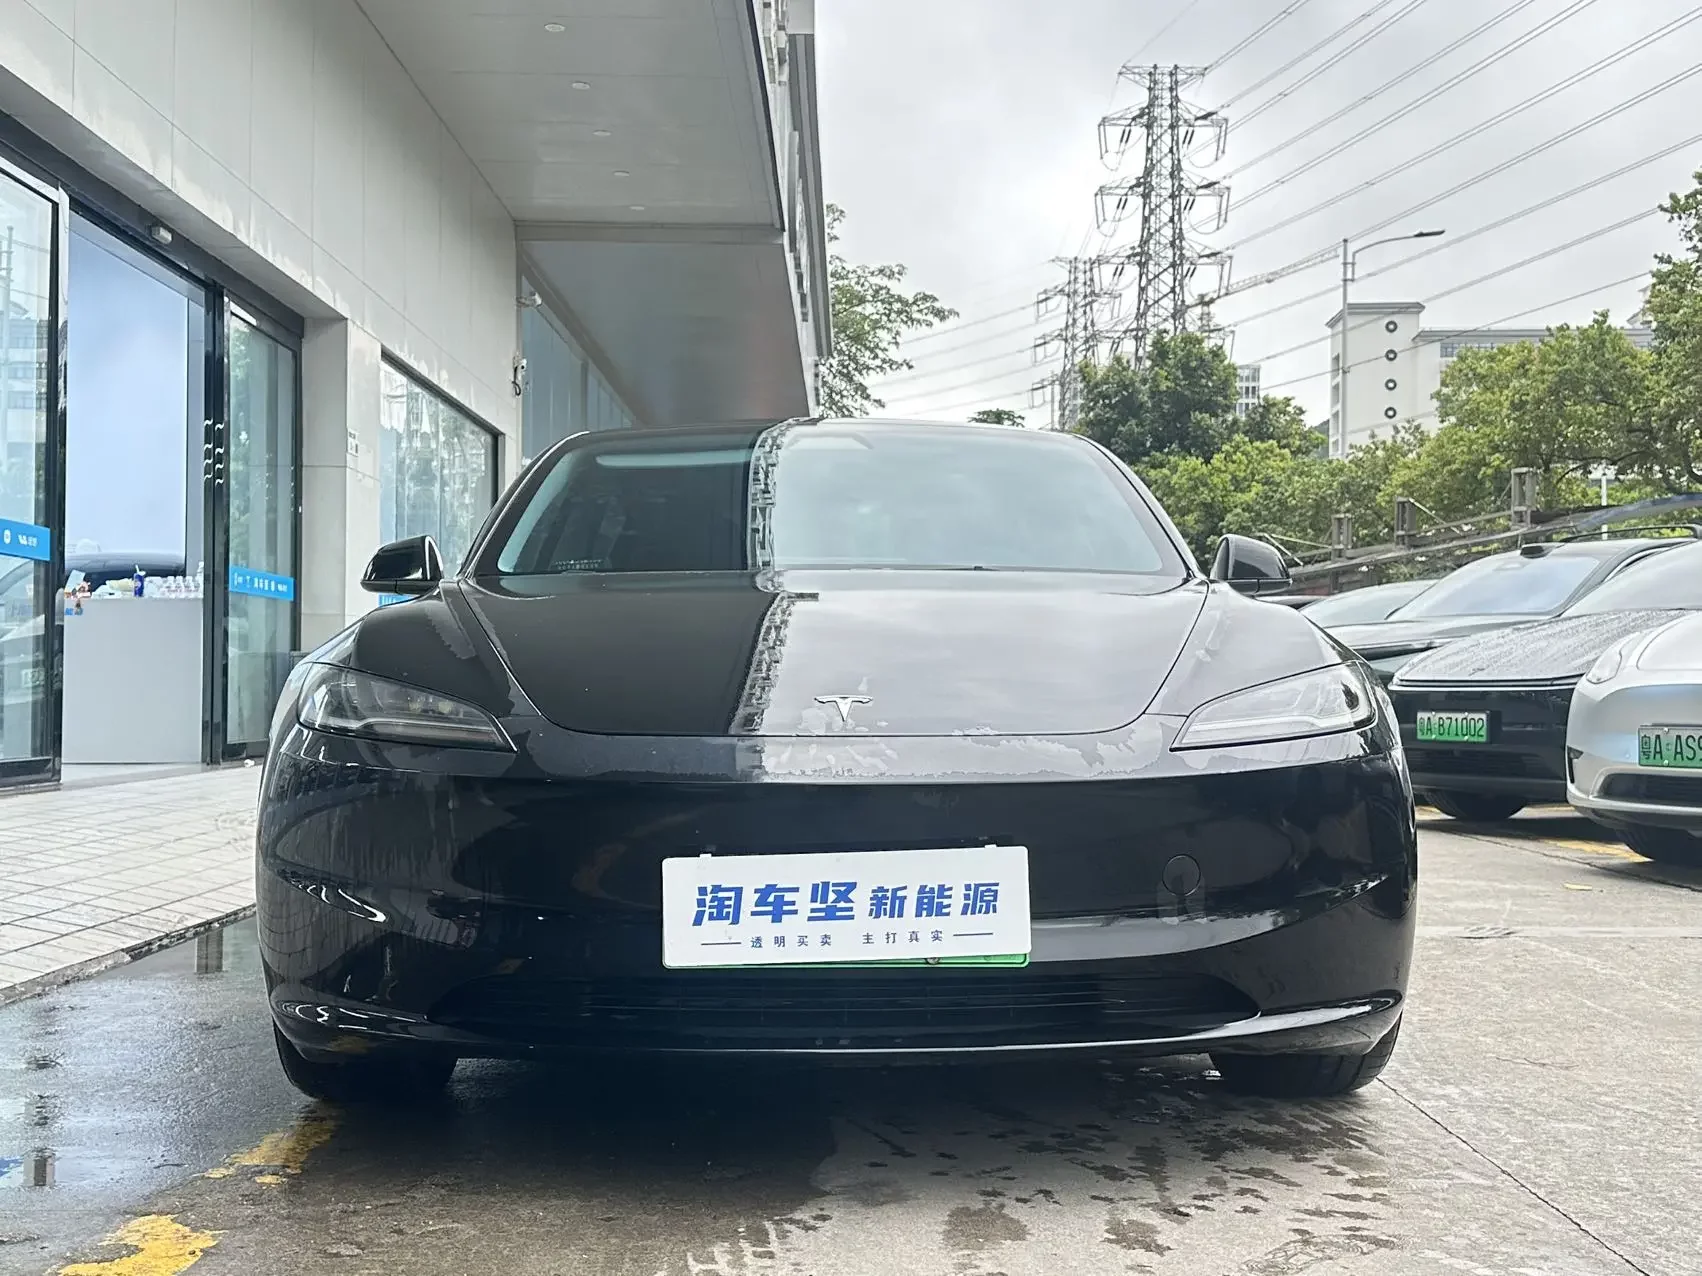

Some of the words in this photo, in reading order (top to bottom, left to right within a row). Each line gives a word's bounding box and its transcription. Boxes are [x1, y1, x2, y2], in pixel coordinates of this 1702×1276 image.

[750, 934, 833, 949] 透明买卖
[861, 929, 944, 945] 主打真实
